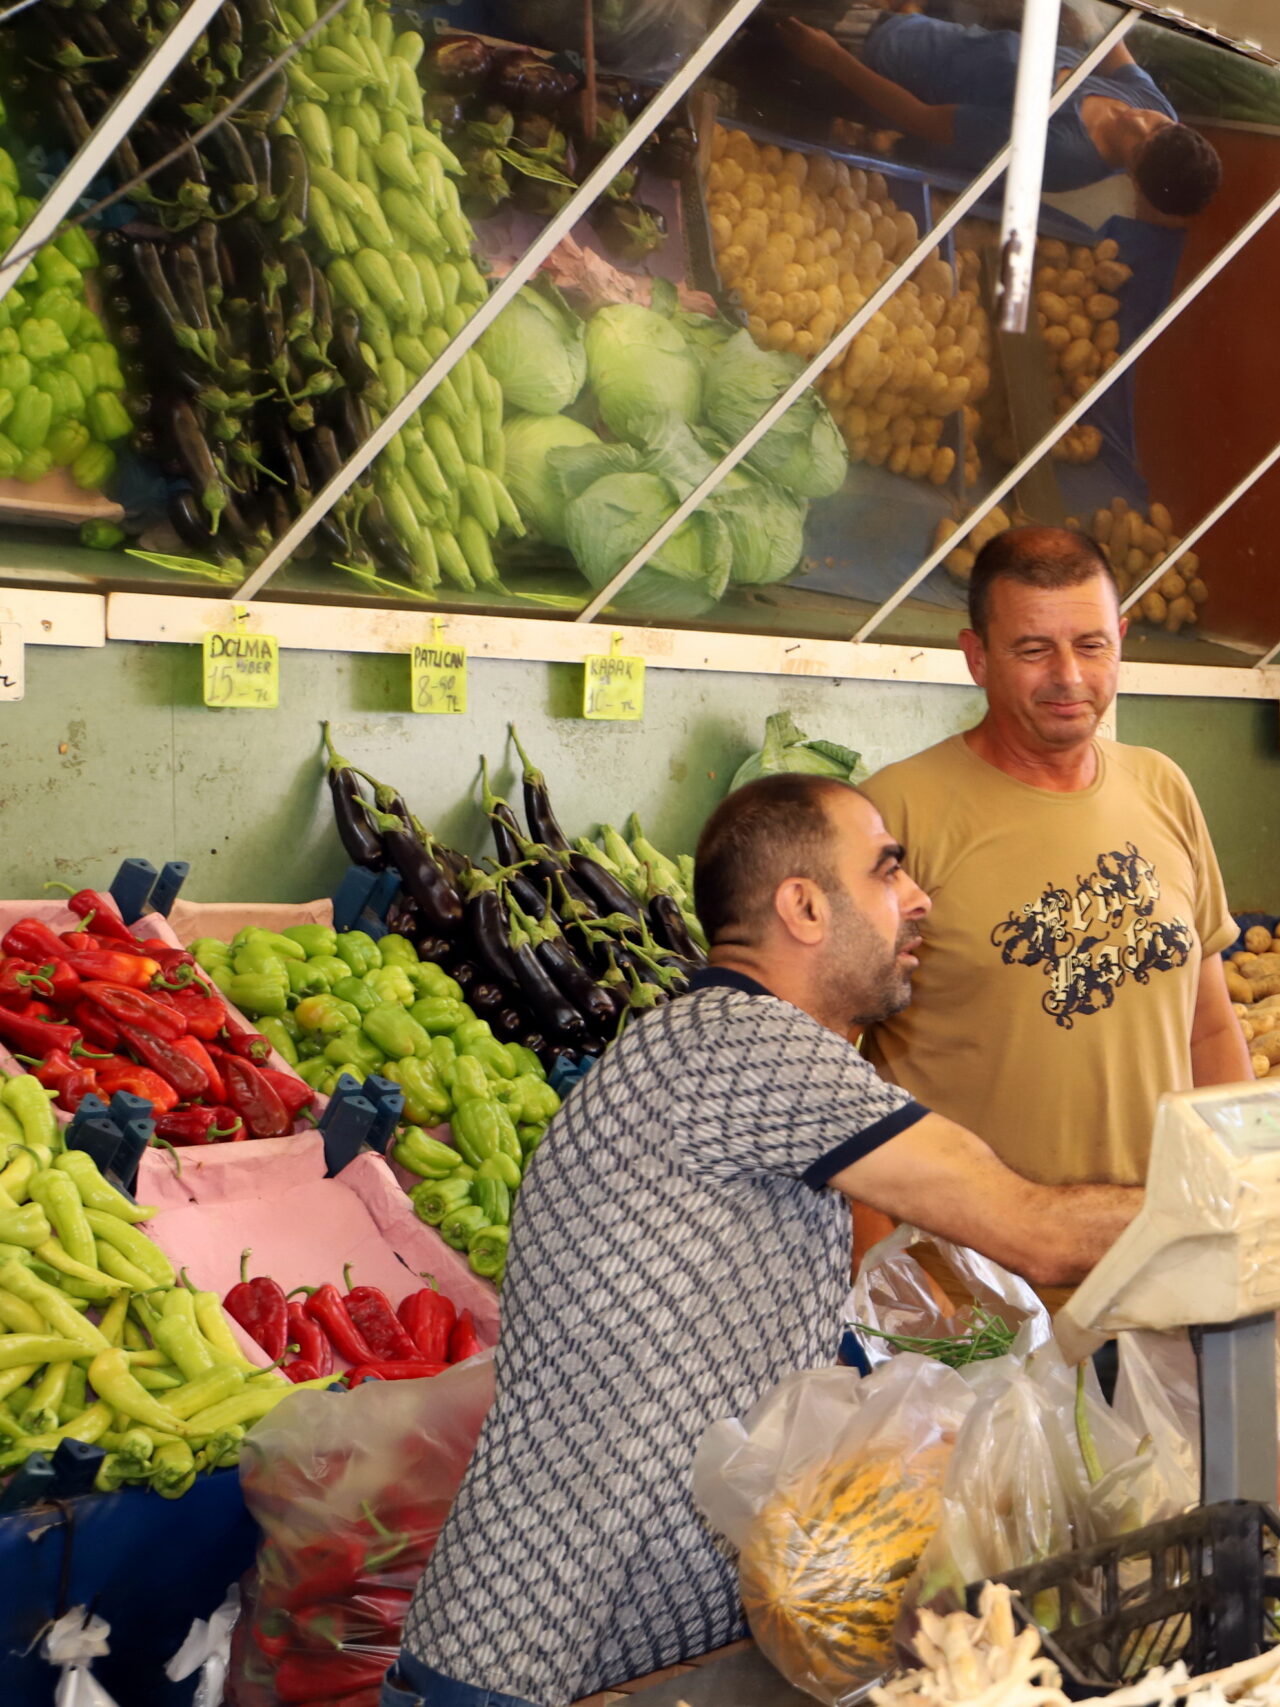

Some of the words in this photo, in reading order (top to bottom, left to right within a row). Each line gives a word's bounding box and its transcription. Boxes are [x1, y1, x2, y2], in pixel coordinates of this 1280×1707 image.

[210, 634, 272, 658] DOLMA
[591, 658, 633, 680] KABAK
[446, 694, 462, 712] TL
